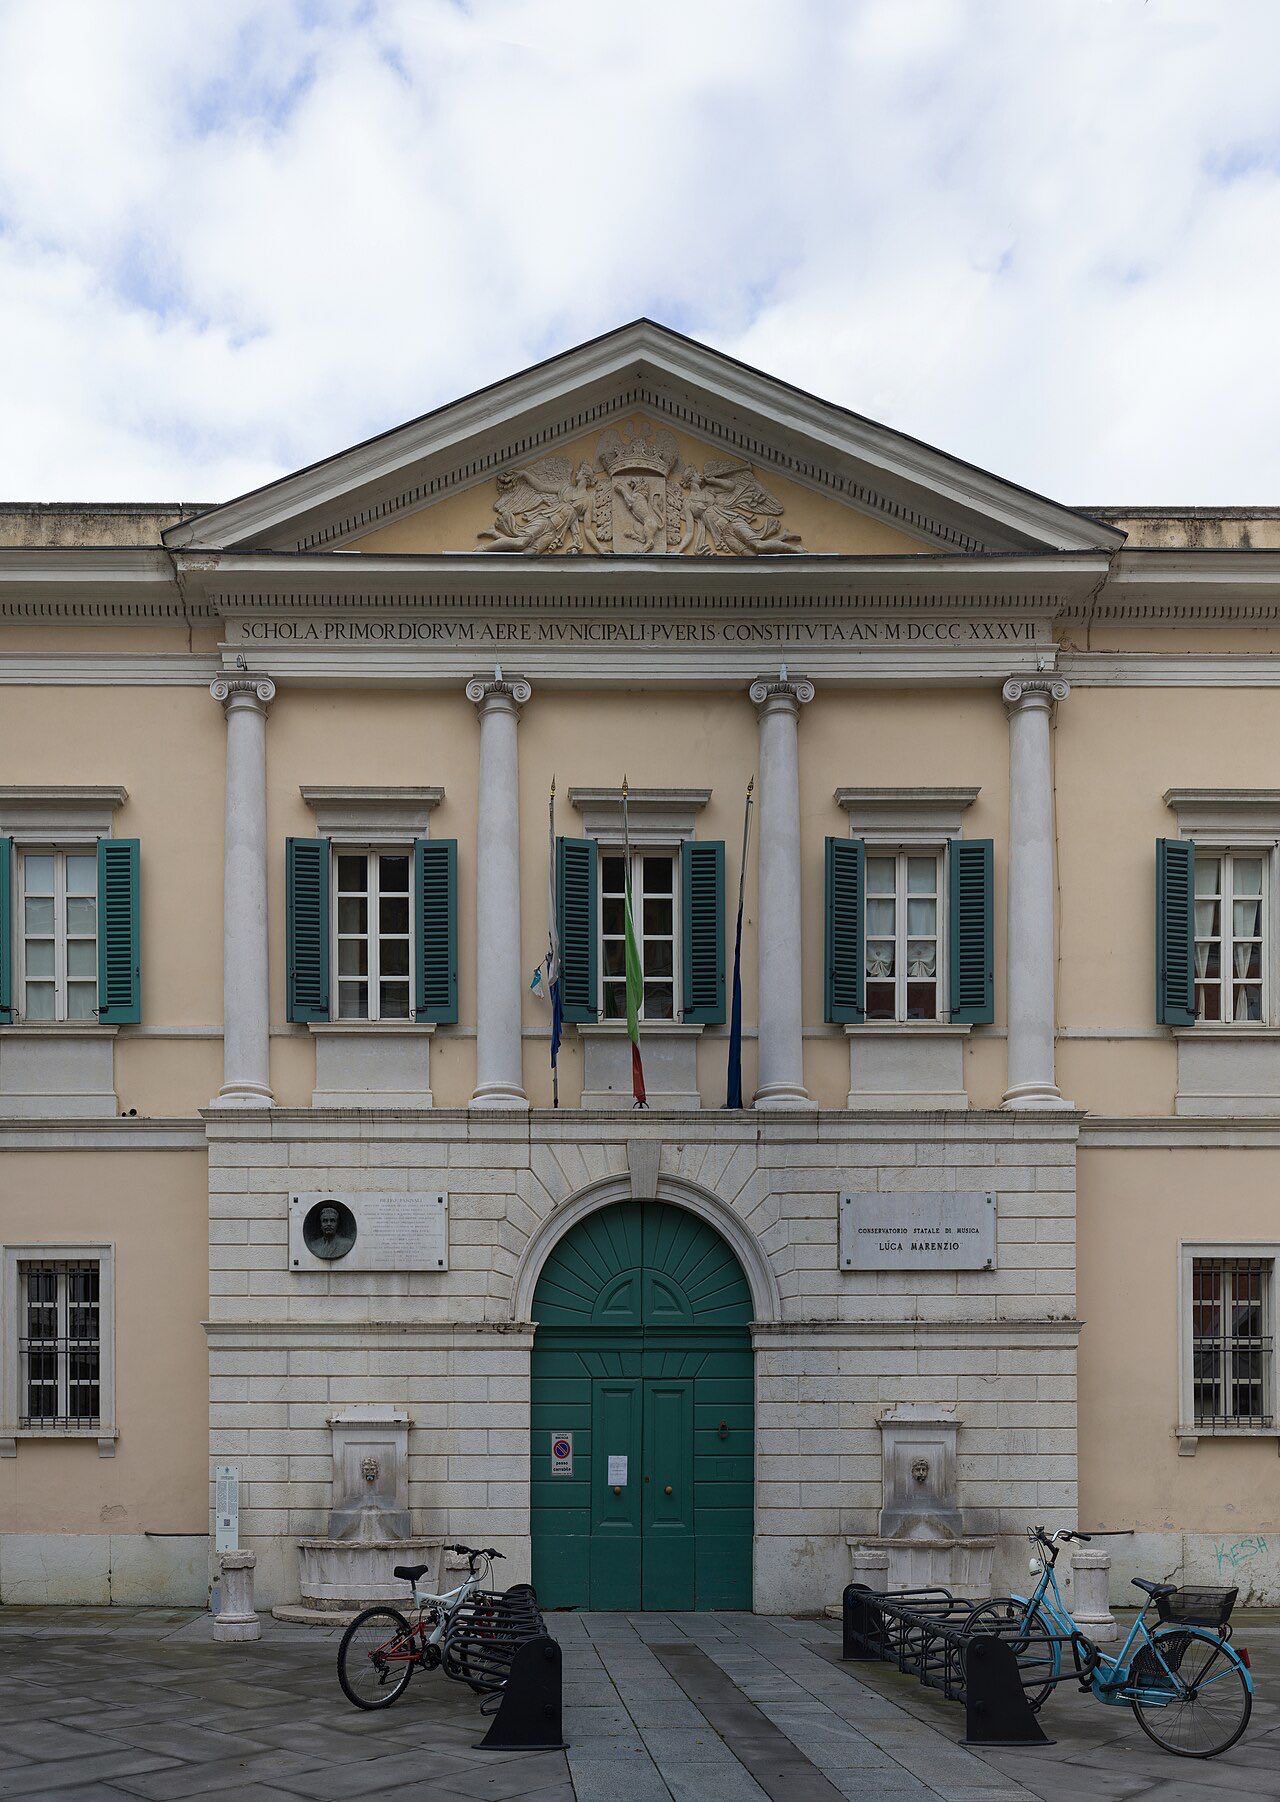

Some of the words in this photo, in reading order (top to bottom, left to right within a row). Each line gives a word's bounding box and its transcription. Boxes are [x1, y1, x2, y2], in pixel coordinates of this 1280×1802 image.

[241, 622, 320, 641] SCHOLA
[324, 622, 475, 641] PRIMORDIORVM
[480, 622, 532, 641] AERE
[537, 622, 647, 641] MVNICIPALI
[651, 622, 716, 641] PVERIS
[723, 622, 845, 641] CONSTITVTA
[849, 622, 878, 641] AN
[884, 622, 900, 641] M
[906, 622, 961, 641] DCCC
[968, 622, 1036, 641] XXXVII
